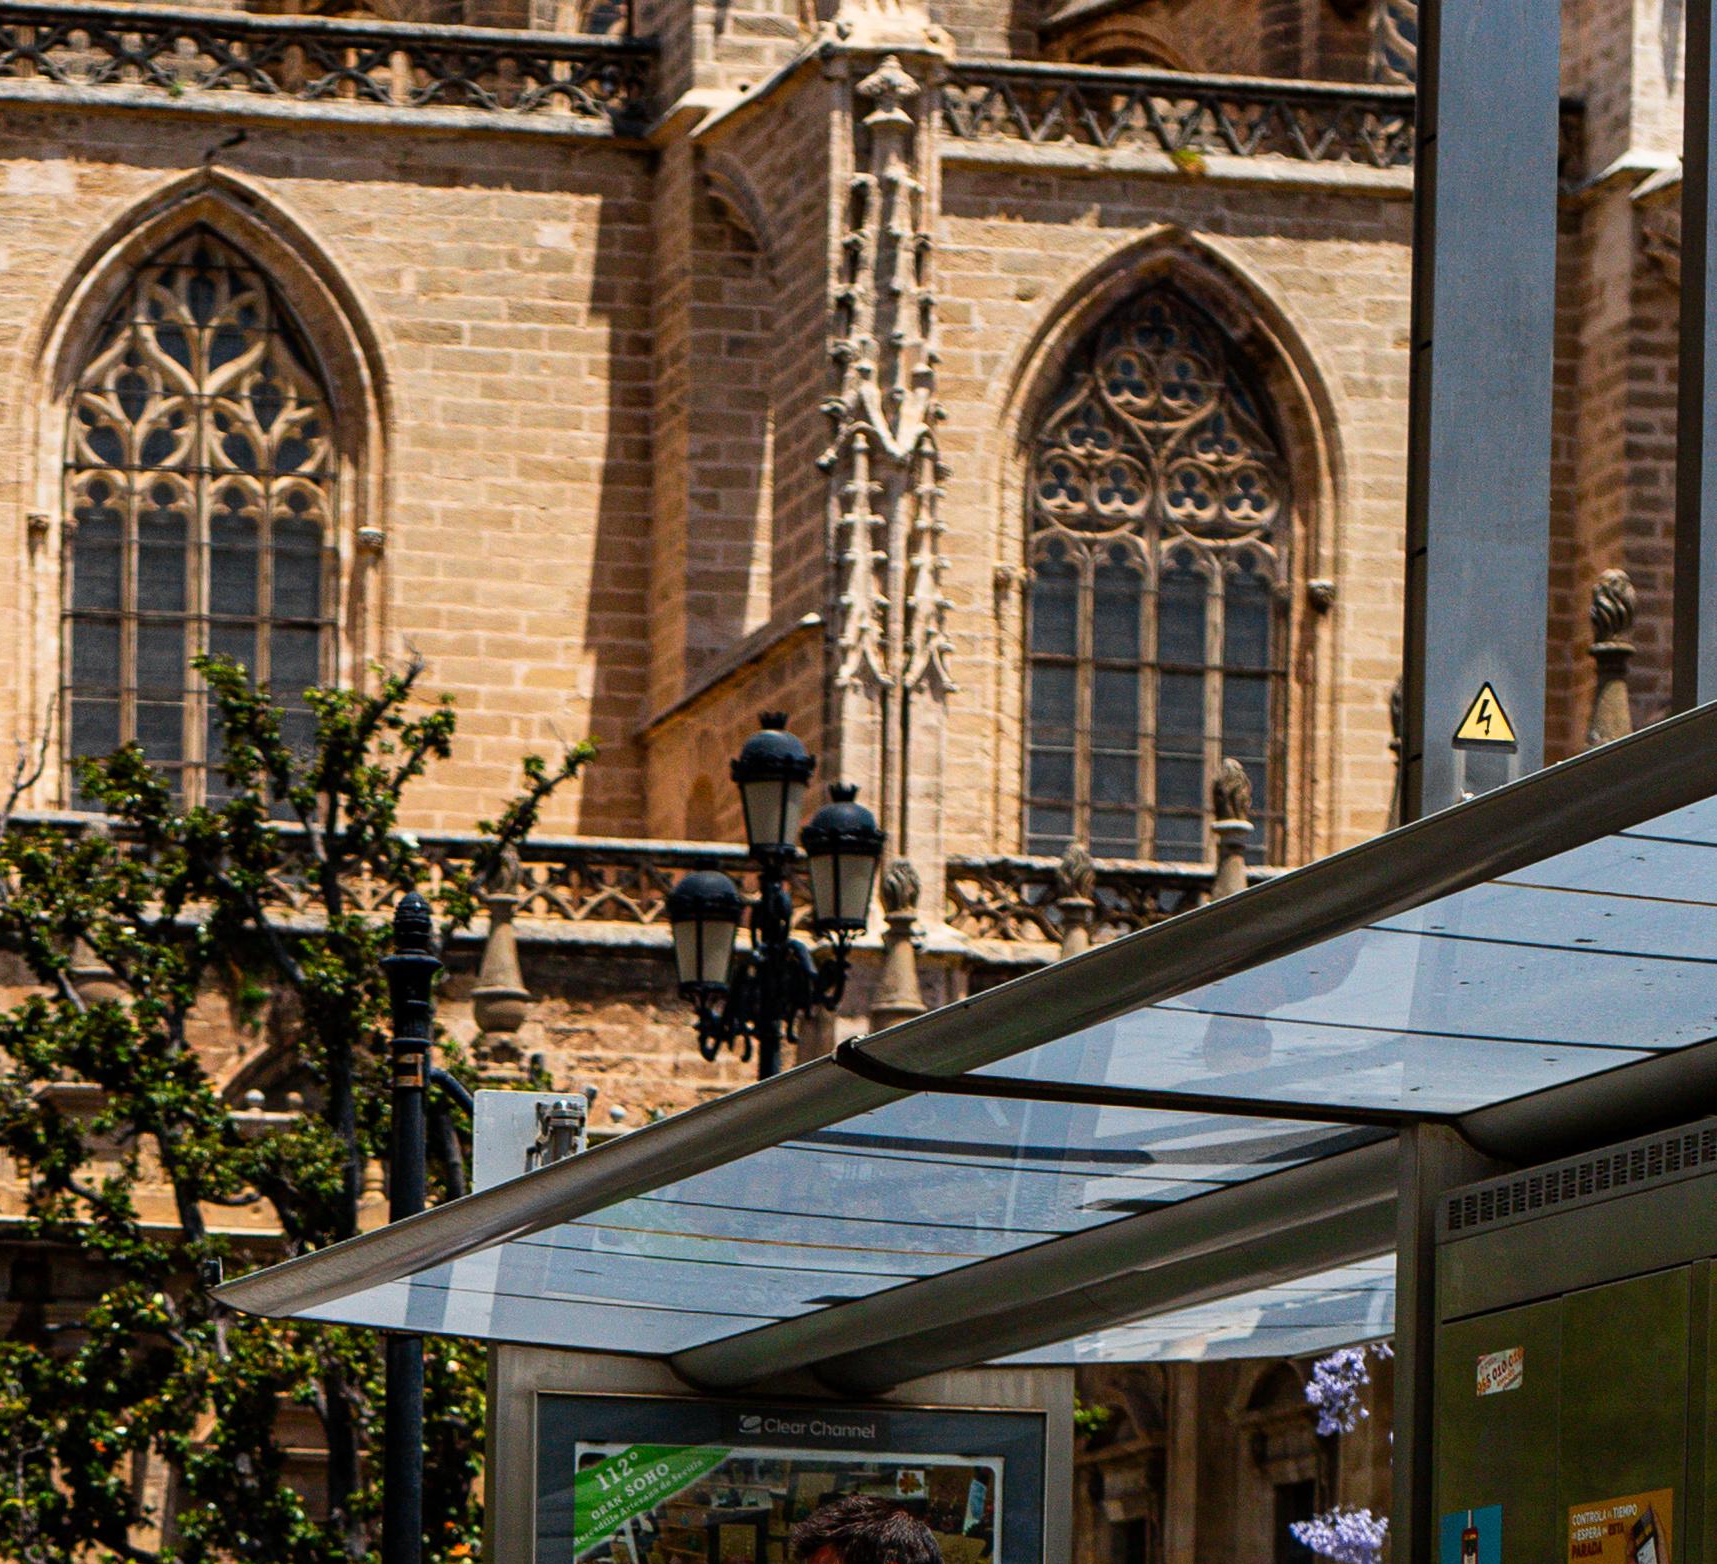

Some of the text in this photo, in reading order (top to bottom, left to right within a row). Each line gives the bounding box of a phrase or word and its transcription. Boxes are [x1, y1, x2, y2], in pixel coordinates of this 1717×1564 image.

[764, 1418, 876, 1439] Clear Channel
[591, 1463, 669, 1520] GRAN SOHO
[1572, 1510, 1606, 1526] CONTROLA
[1613, 1504, 1638, 1520] TIEMPO
[1577, 1526, 1602, 1541] ESPERA
[1608, 1521, 1624, 1536] ESTA
[1571, 1540, 1603, 1559] PARADA
